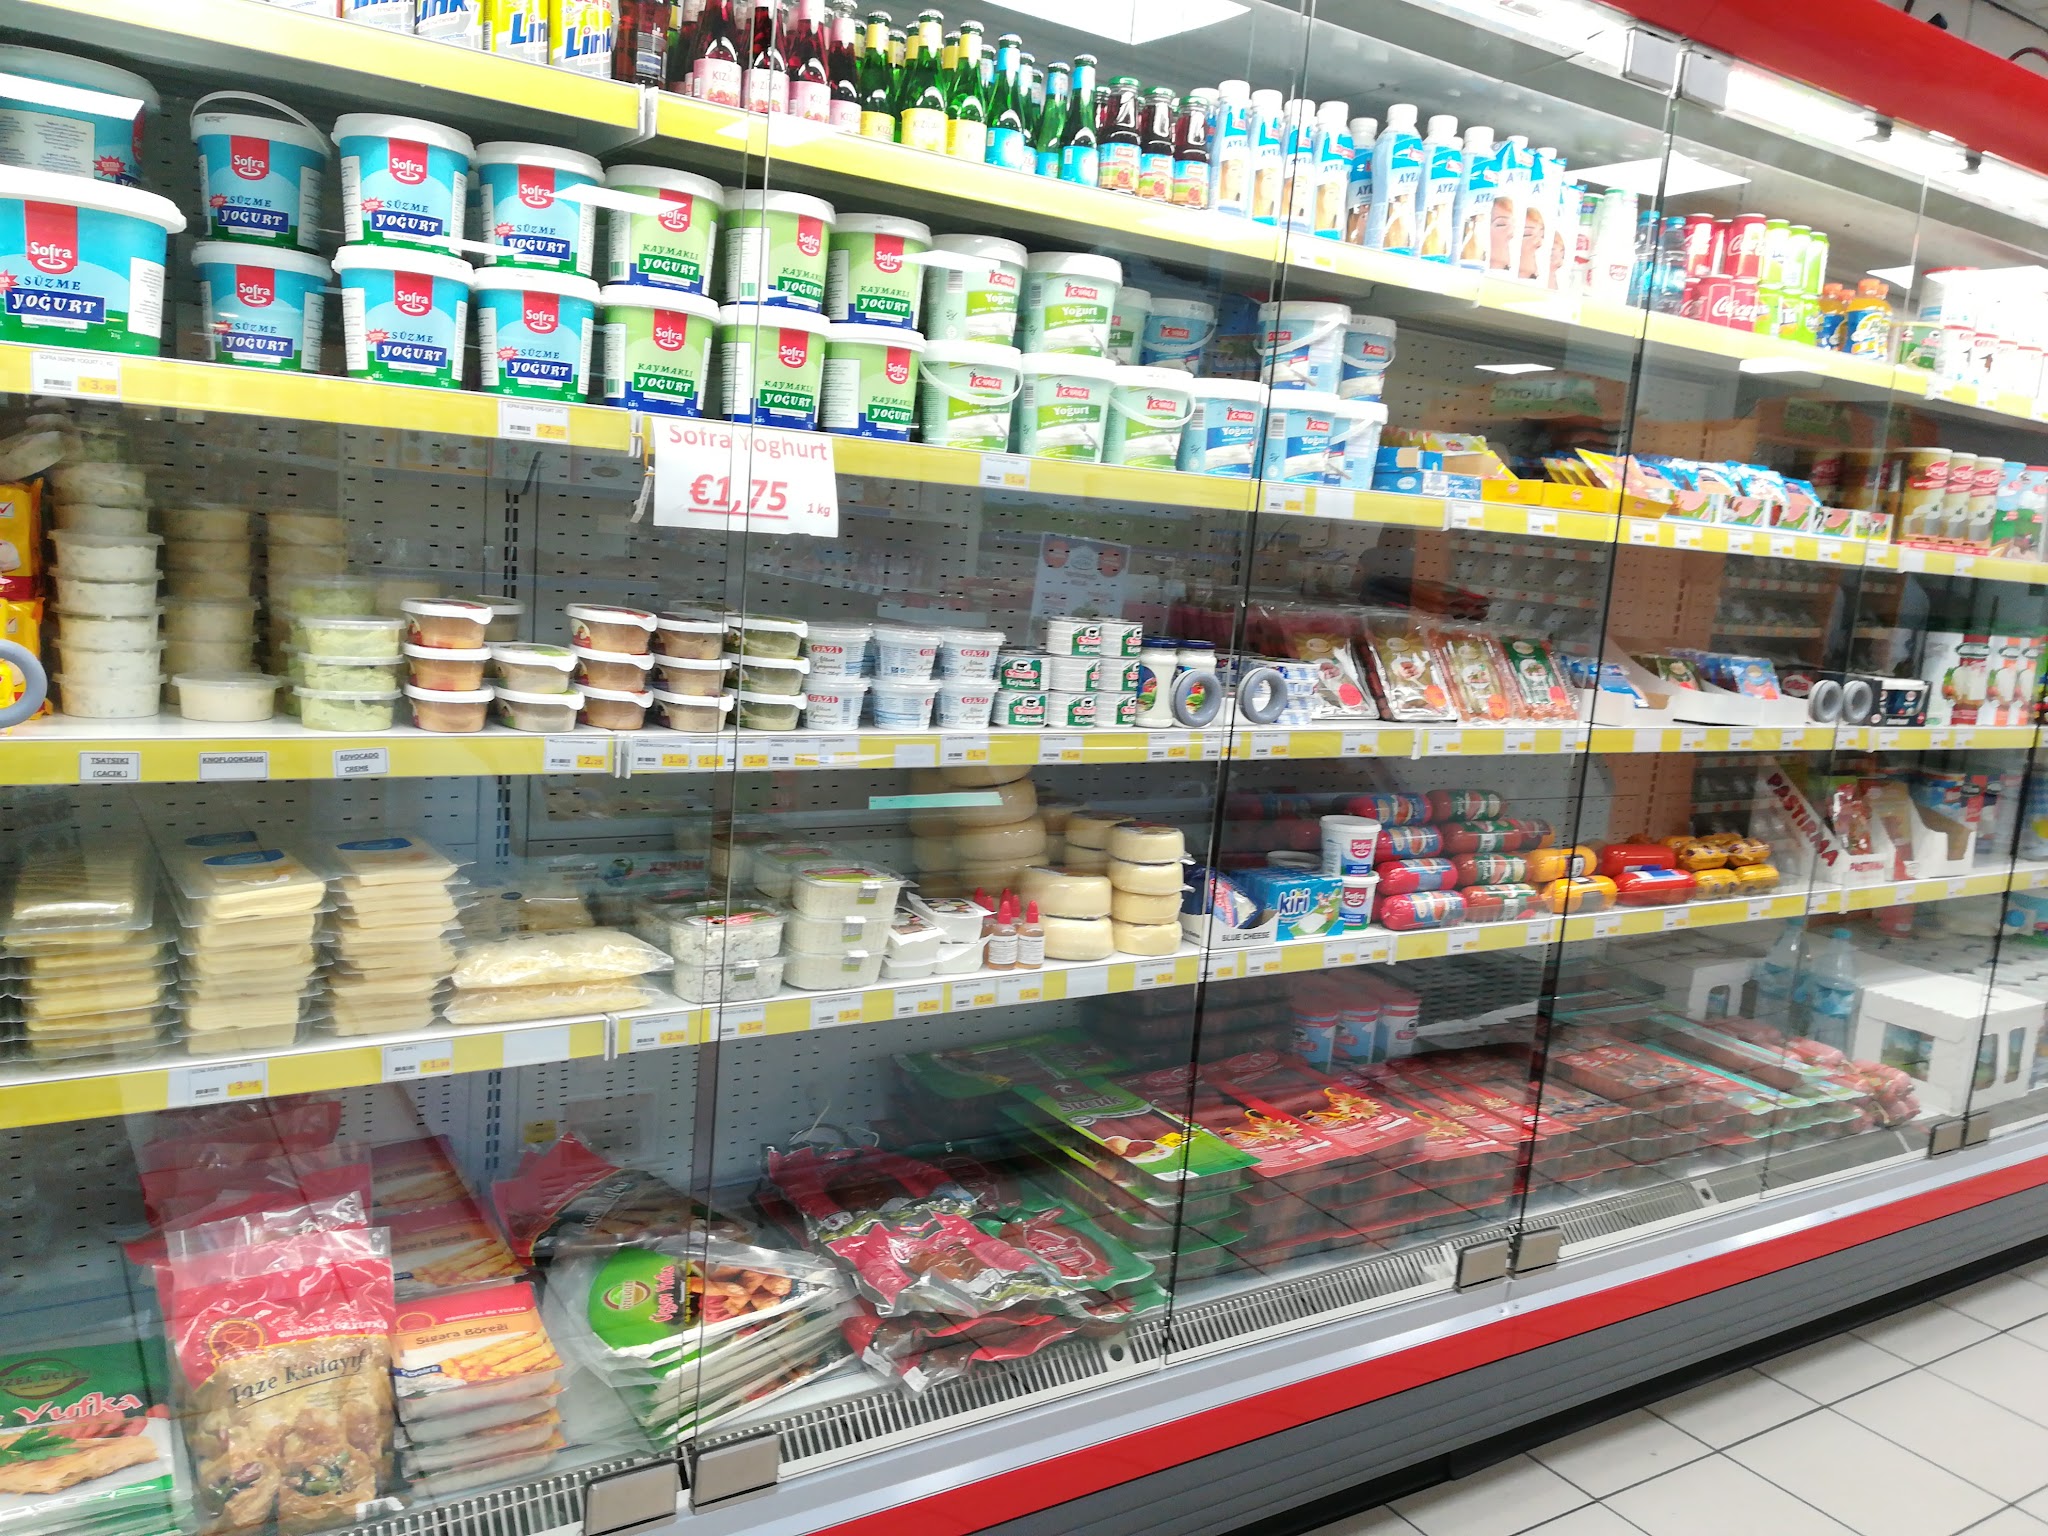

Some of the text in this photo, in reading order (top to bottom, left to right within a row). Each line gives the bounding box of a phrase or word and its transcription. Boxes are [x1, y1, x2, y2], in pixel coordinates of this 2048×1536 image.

[510, 13, 547, 45] Lin
[233, 155, 265, 169] Sofra
[391, 157, 424, 173] Sofra
[521, 184, 551, 197] Sofra
[229, 196, 272, 208] SÜZME
[386, 199, 429, 214] SÜZME
[221, 209, 283, 227] YOĞURT
[375, 213, 439, 232] YOĞURT
[661, 208, 689, 223] Sofra
[516, 224, 556, 236] SÜZME
[507, 236, 566, 253] YOĞURT
[799, 232, 820, 247] Sofra
[30, 241, 73, 260] Sofra
[642, 243, 699, 261] KAYMAKLI
[876, 250, 902, 263] Sofra
[643, 257, 698, 276] YOĞURT
[24, 275, 81, 291] SÜZME
[239, 282, 271, 297] Sofra
[781, 278, 823, 298] YOĞURT
[397, 290, 429, 305] Sofra
[860, 284, 910, 298] KAYMAKLI
[12, 293, 97, 314] YOĞURT
[860, 296, 909, 313] YOĞURT
[525, 309, 555, 323] Sofra
[1061, 305, 1098, 318] Yoğurt
[235, 322, 278, 334] SÜZME
[655, 326, 683, 341] Sofra
[226, 336, 288, 352] YOĞURT
[391, 331, 434, 344] SÜZME
[381, 345, 443, 361] YOĞURT
[520, 348, 560, 359] SÜZME
[780, 345, 805, 359] Sofra
[511, 361, 569, 377] YOĞURT
[637, 362, 693, 378] KAYMAKLI
[888, 363, 908, 376] Sofra
[637, 377, 692, 392] YOĞURT
[764, 379, 813, 393] KAYMAKLI
[764, 392, 812, 408] YOĞURT
[872, 407, 911, 422] YOĞURT
[1052, 405, 1090, 417] Yoğurt
[669, 424, 828, 461] Sofra Yoghurt
[689, 474, 788, 513] €1,75
[813, 645, 842, 653] GAZI
[810, 694, 837, 703] GAZI
[1279, 887, 1311, 915] kiri
[1344, 891, 1366, 900] Sofra
[1222, 931, 1270, 942] BLUE CHEESE
[415, 1331, 461, 1345] Sigara
[13, 1391, 144, 1424] Yufka
